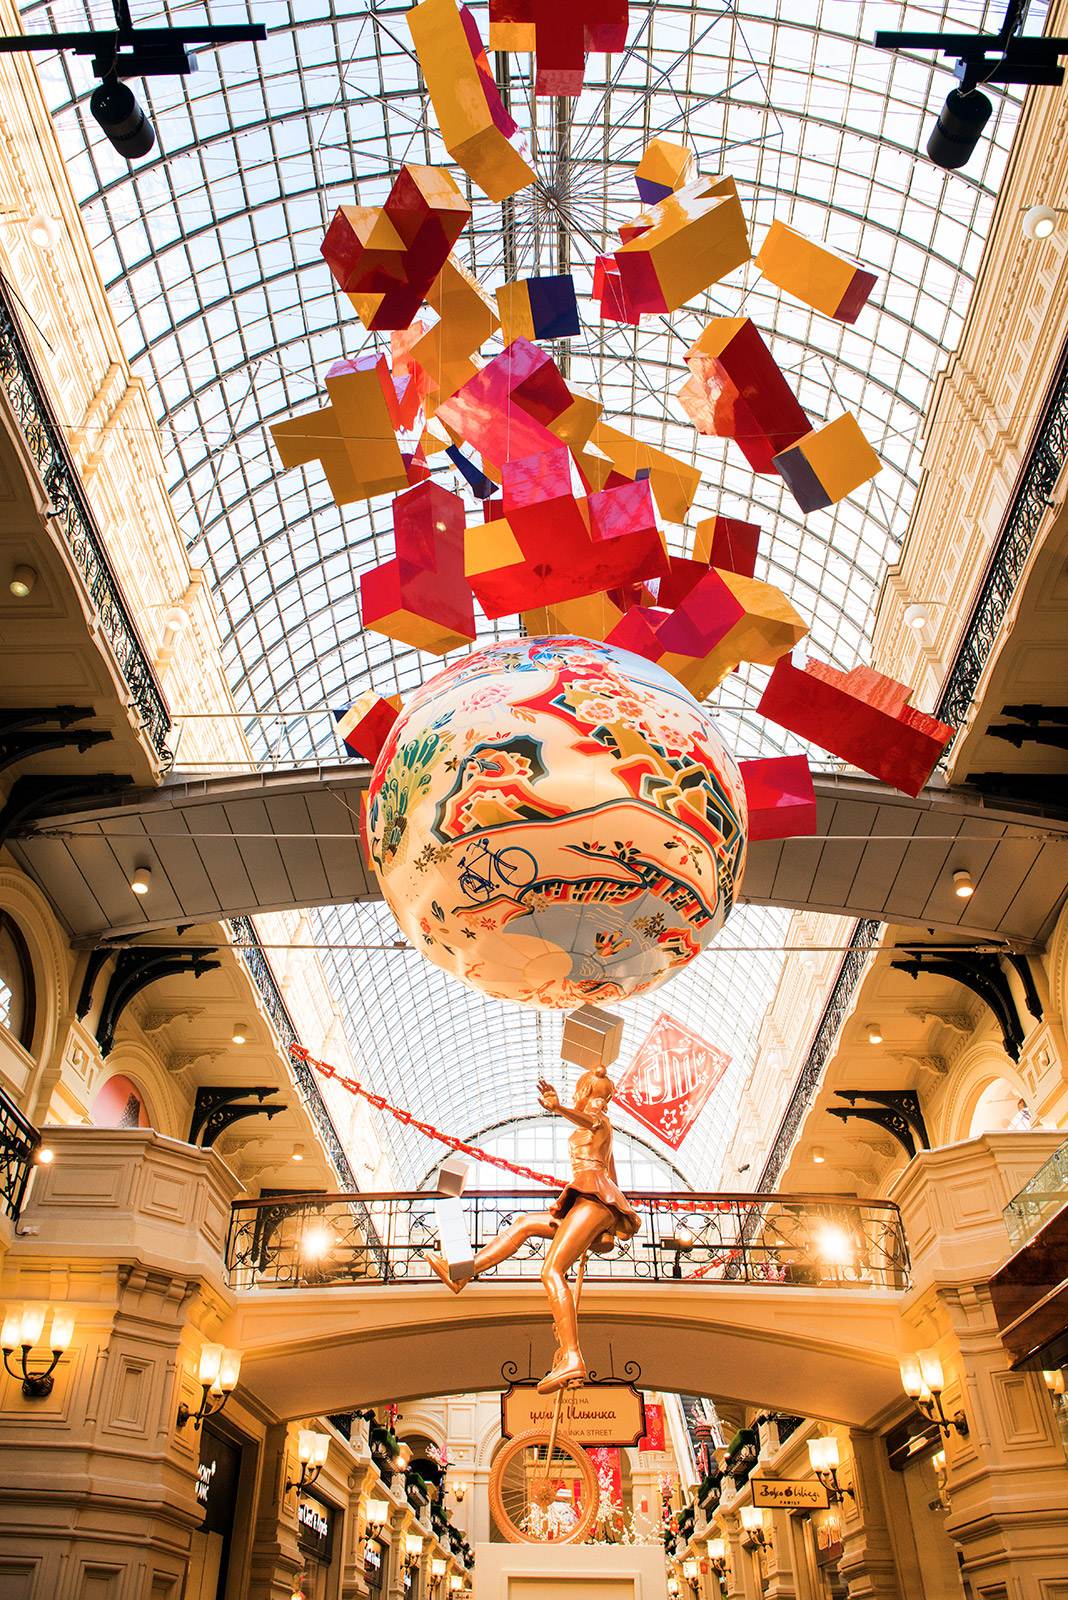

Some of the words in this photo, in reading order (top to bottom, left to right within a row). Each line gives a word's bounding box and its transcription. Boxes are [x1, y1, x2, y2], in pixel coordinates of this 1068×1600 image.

[530, 1411, 564, 1424] улиу
[567, 1406, 616, 1419] Ильинка
[586, 1429, 613, 1437] STREET
